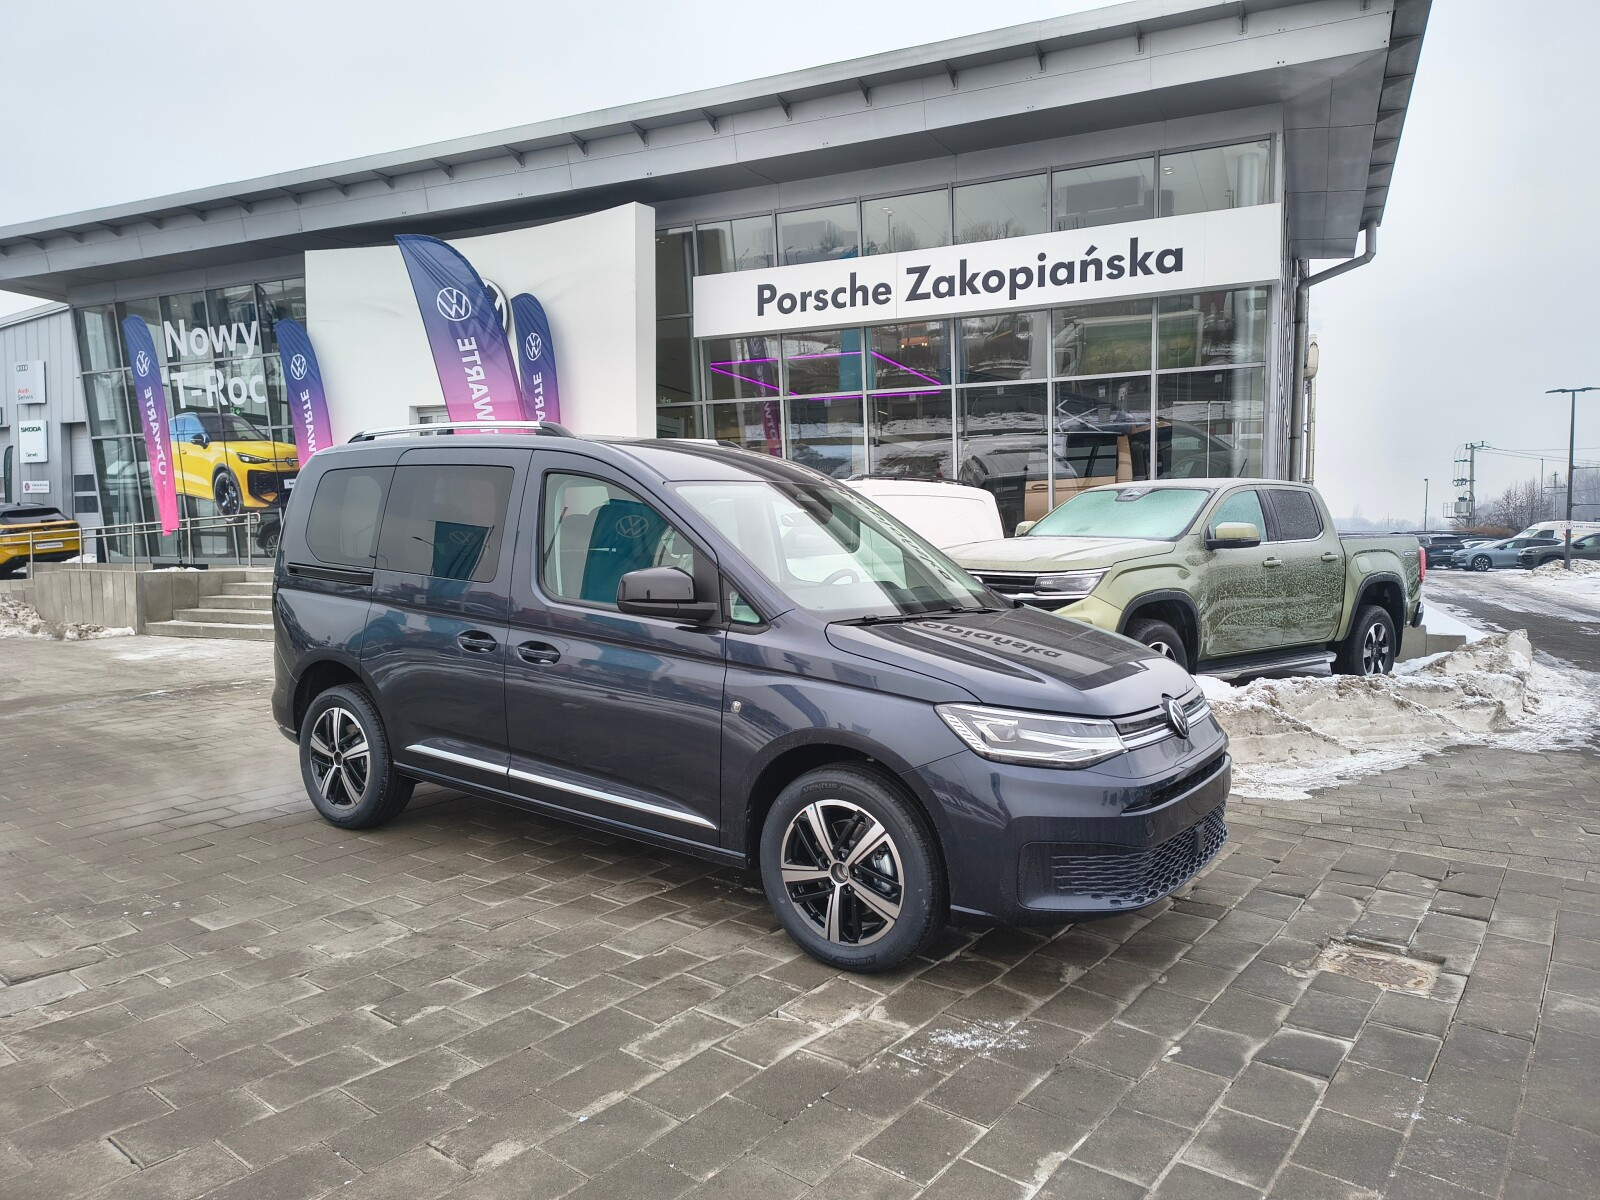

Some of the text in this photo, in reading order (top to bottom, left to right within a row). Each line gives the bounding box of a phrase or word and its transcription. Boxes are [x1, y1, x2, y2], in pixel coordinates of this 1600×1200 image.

[757, 237, 1184, 317] Porsche Zakopiańska
[163, 319, 258, 359] Nowy
[170, 369, 267, 409] T-Roc
